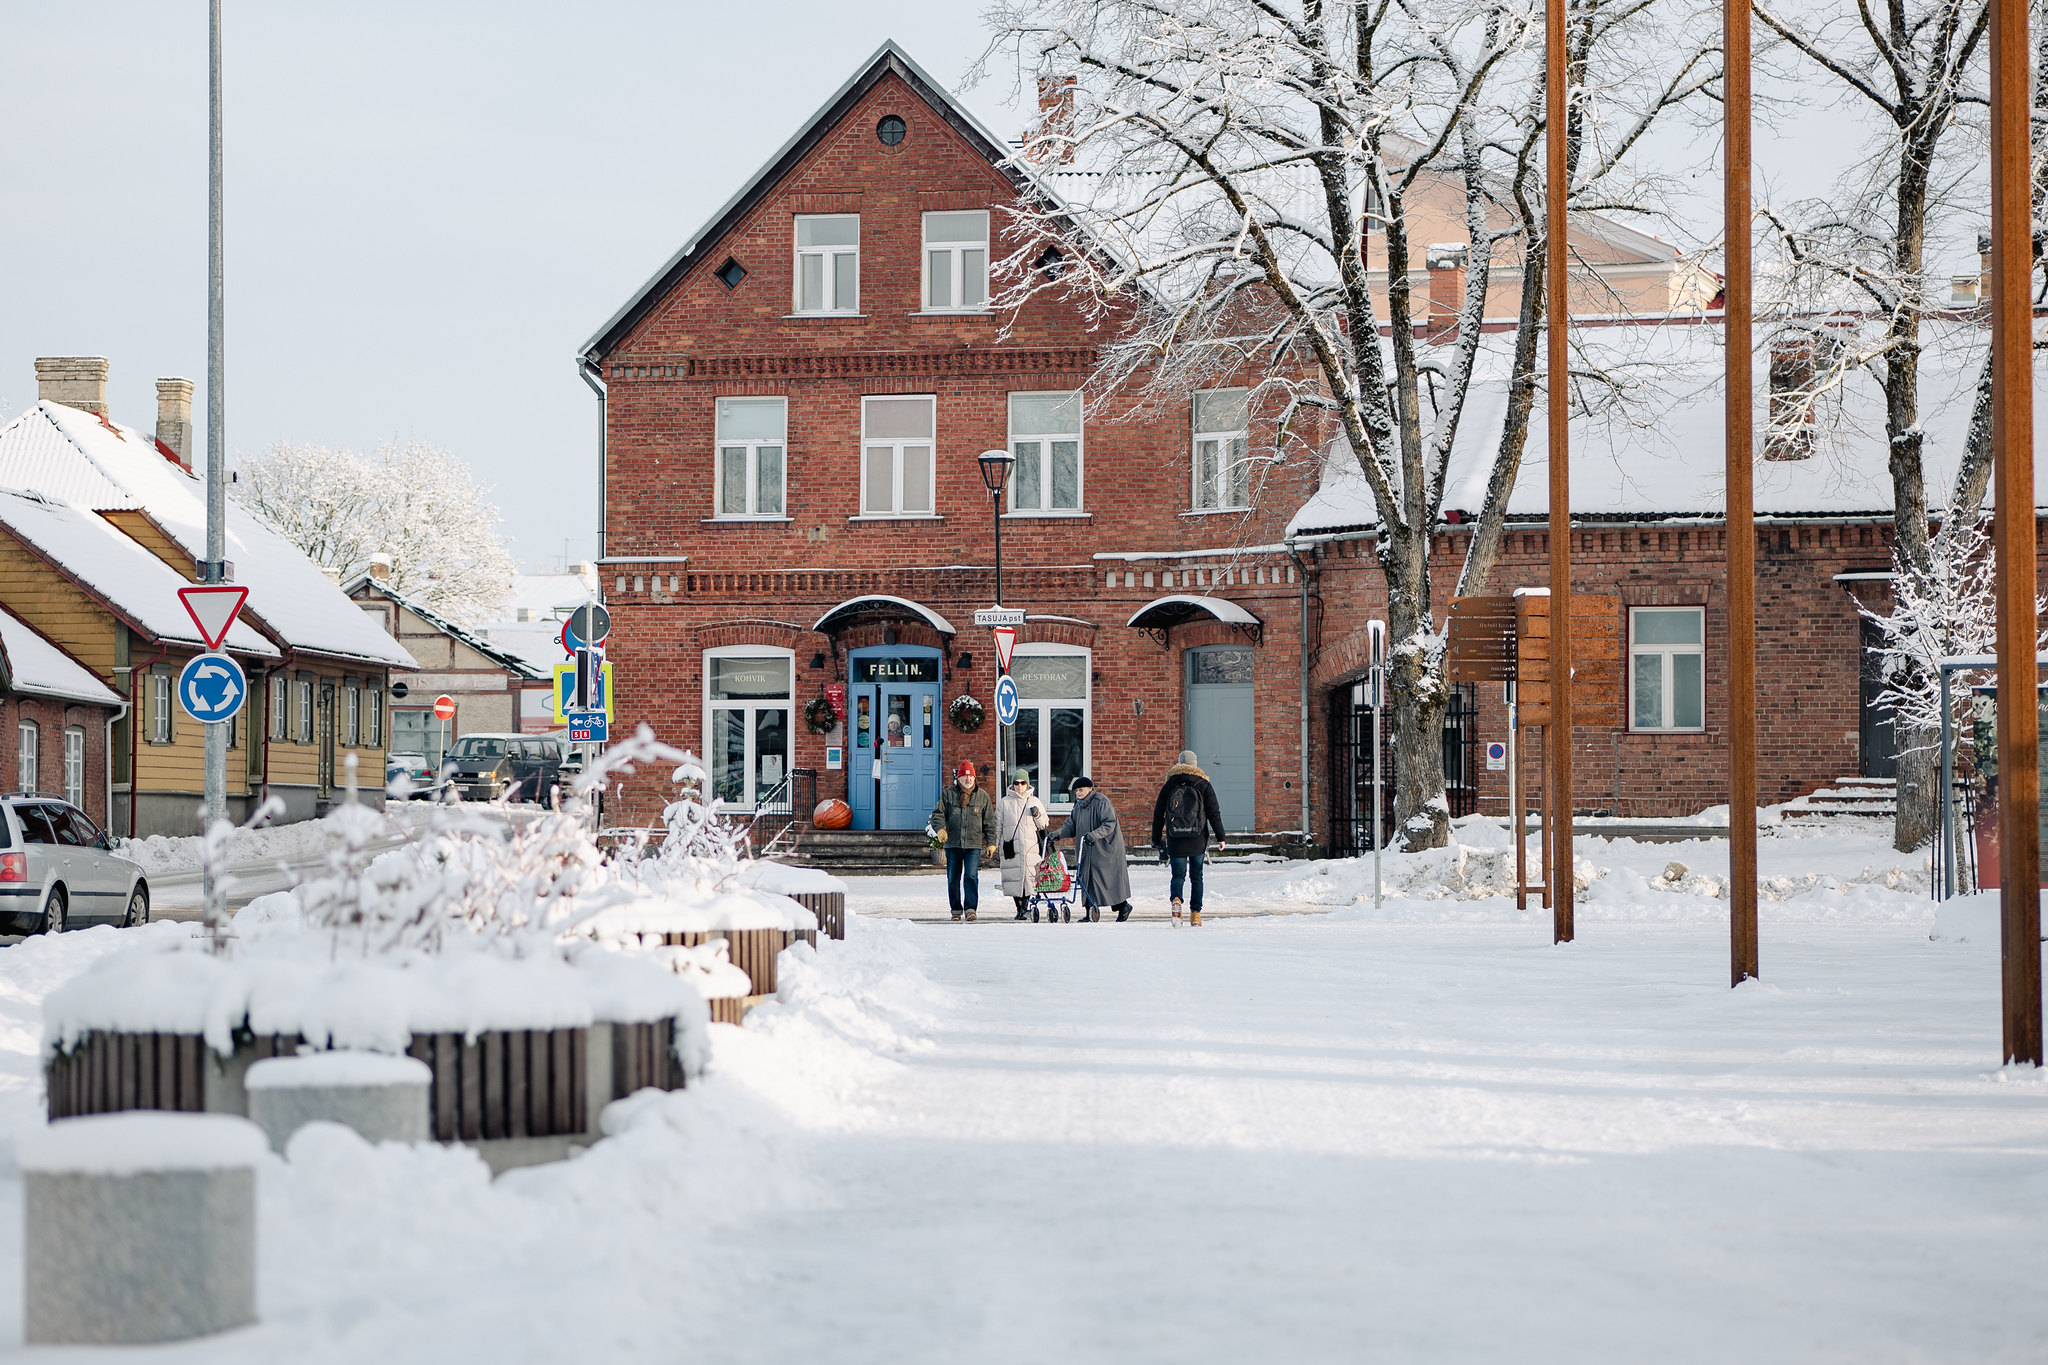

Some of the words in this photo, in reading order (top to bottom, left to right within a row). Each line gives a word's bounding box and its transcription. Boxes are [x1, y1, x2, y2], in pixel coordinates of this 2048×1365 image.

[977, 614, 1008, 622] TASUJA
[1008, 614, 1021, 623] pst
[869, 664, 923, 676] FELLIN.
[734, 674, 766, 682] KOHVIK
[1022, 673, 1067, 681] RESTORAN
